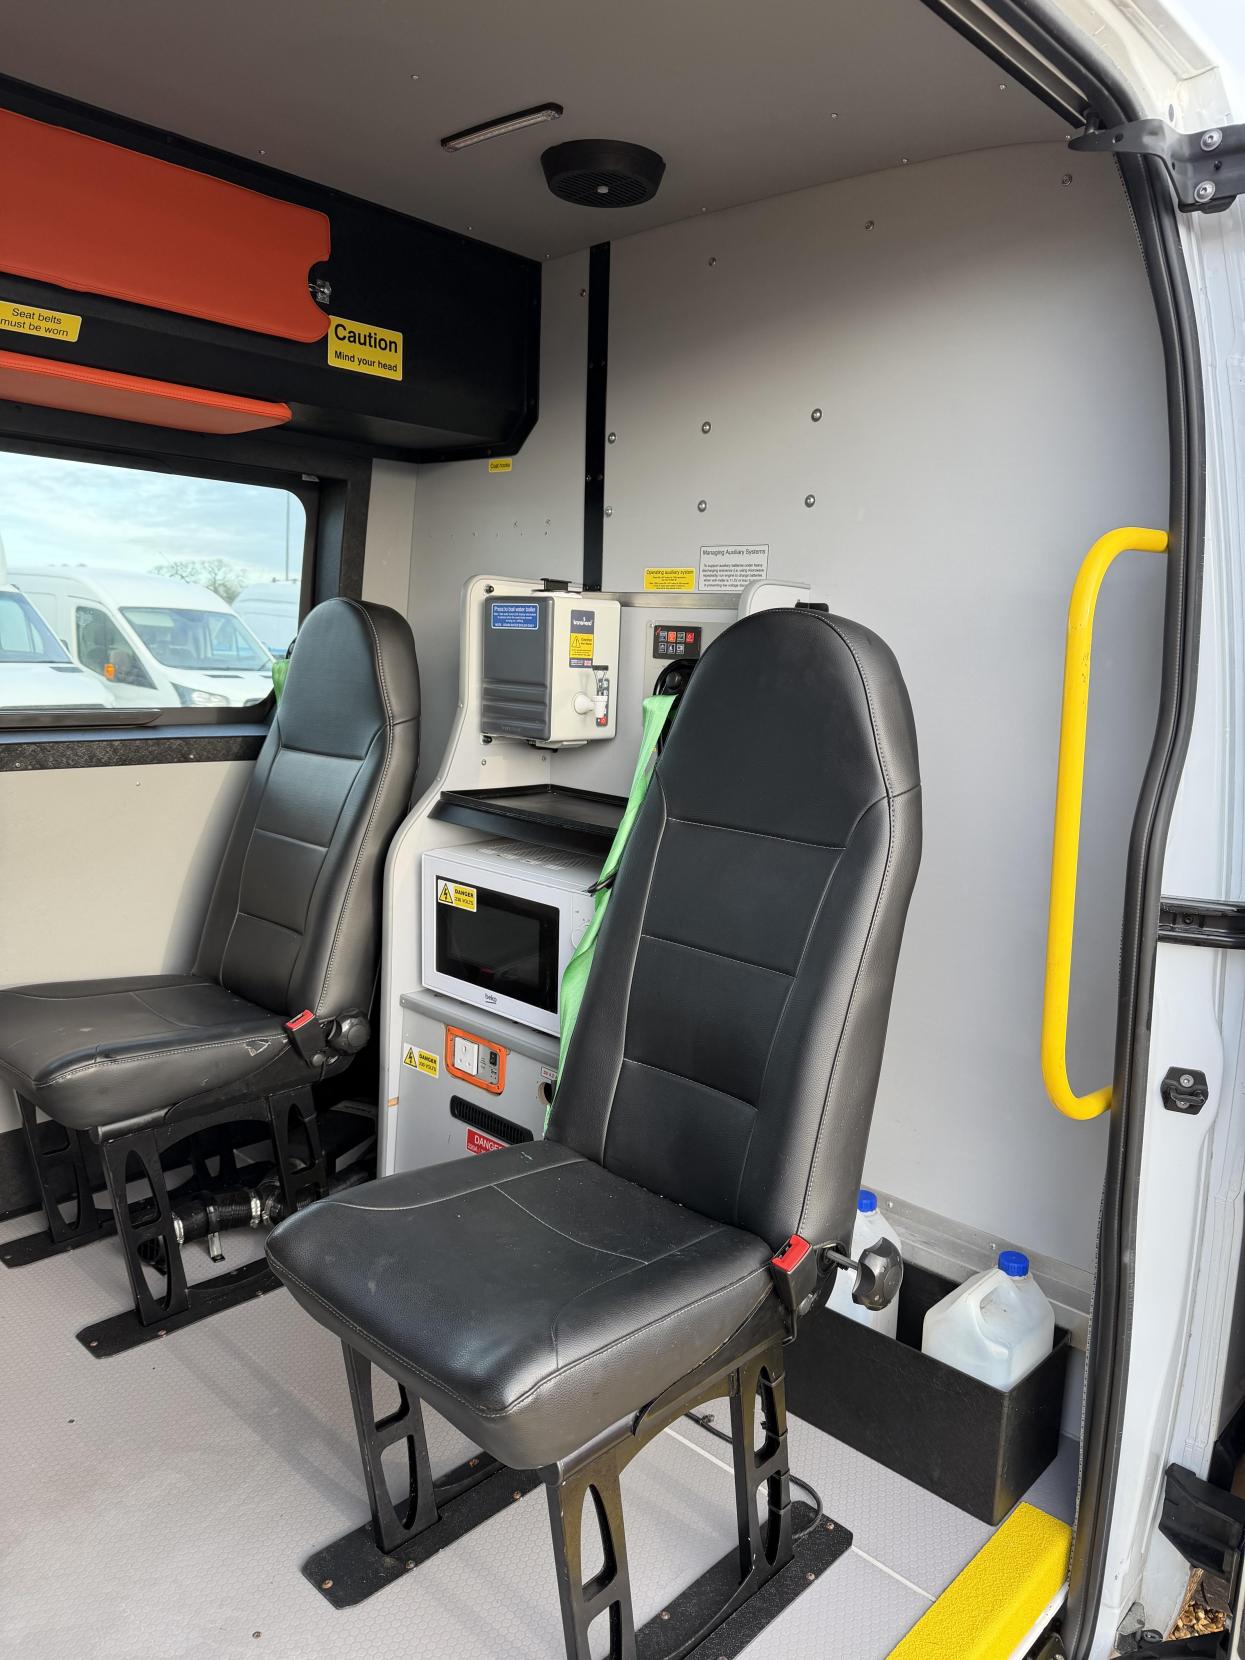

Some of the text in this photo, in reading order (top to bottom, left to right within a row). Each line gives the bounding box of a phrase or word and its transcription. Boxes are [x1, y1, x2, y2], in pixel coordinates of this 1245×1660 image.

[12, 307, 62, 325] Seat belts
[0, 318, 69, 337] must be worn
[334, 323, 398, 353] Caution
[334, 350, 398, 372] Mind your head
[454, 889, 474, 898] DANGER
[485, 993, 498, 1002] beko
[419, 1053, 437, 1065] DANGER
